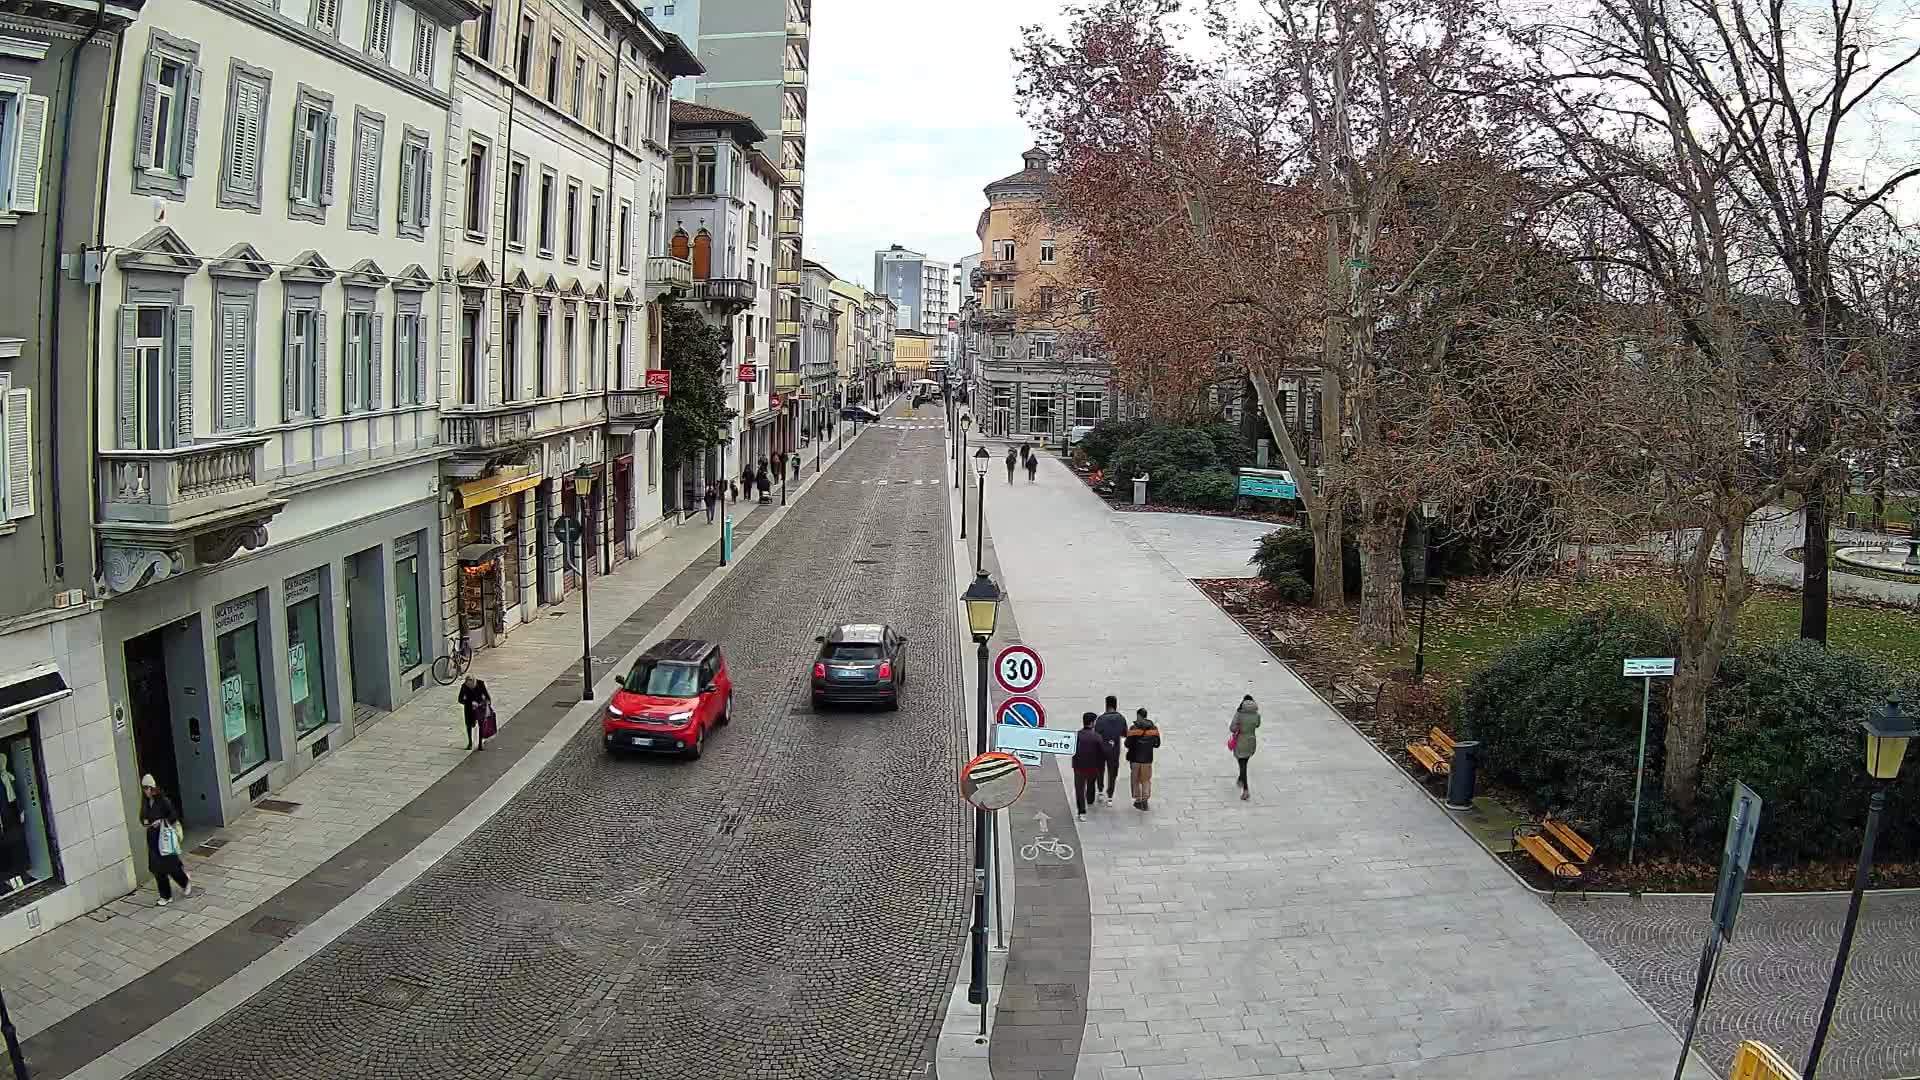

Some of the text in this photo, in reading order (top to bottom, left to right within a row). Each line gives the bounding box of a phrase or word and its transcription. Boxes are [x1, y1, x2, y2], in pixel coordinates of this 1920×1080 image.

[1005, 658, 1034, 681] 30
[222, 679, 241, 701] 130
[1038, 738, 1070, 750] Dante
